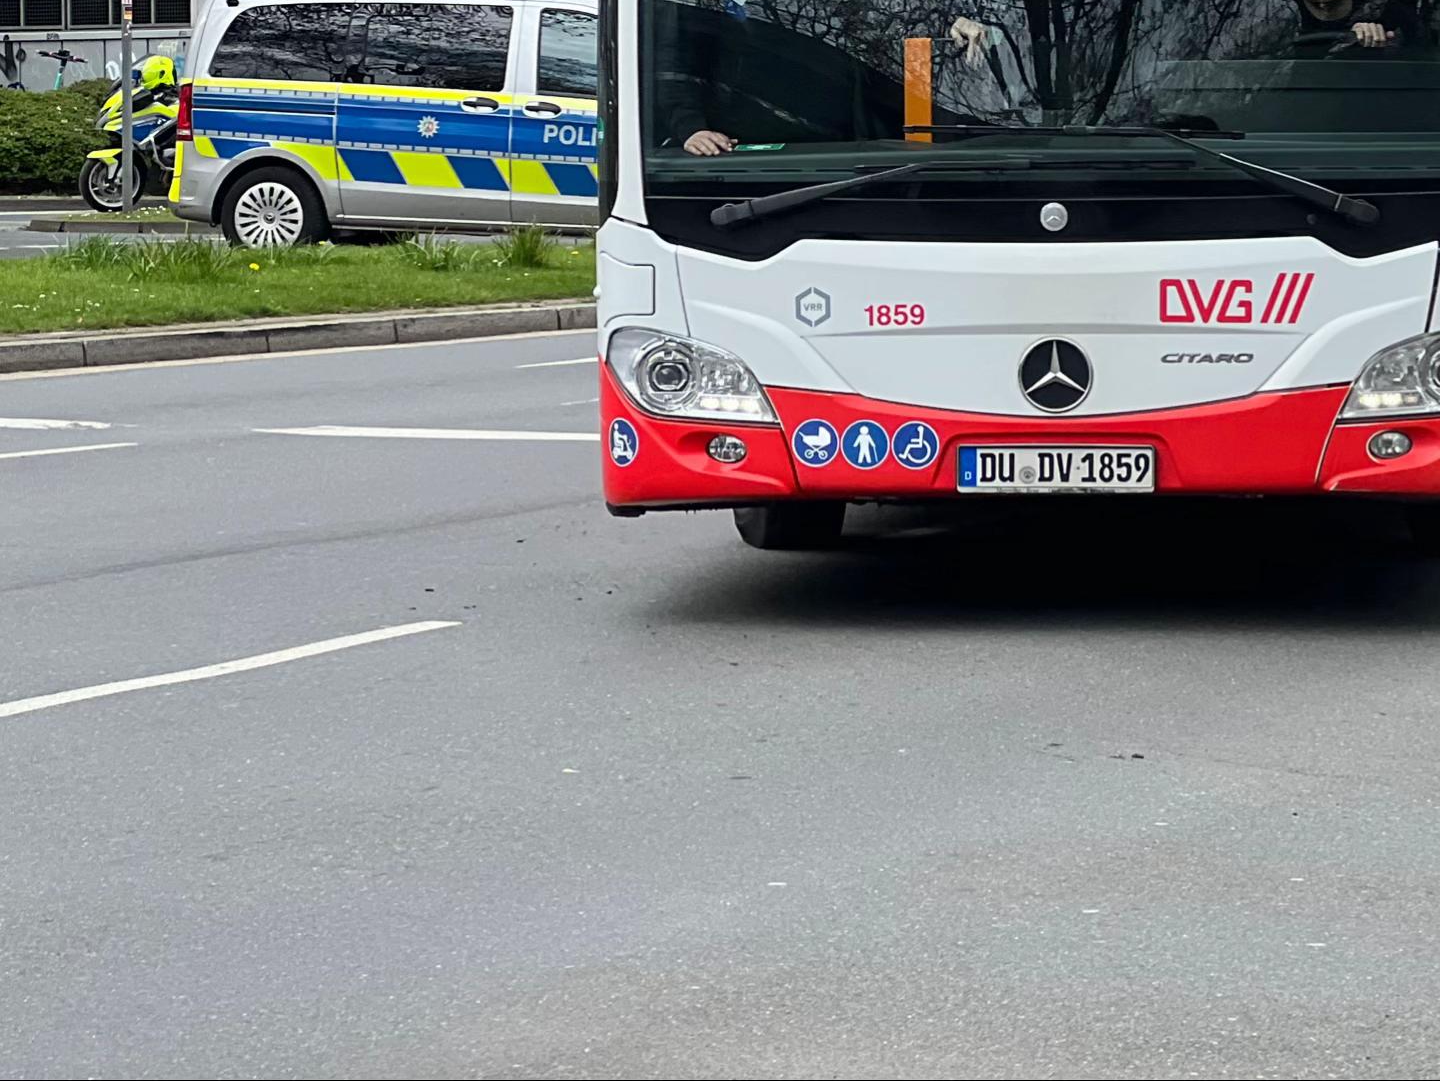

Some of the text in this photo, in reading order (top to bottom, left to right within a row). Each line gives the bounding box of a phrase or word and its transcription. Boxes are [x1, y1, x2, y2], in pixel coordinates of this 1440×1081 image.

[543, 124, 597, 146] POLI
[803, 303, 823, 311] VRR
[864, 304, 925, 326] 1859
[1160, 353, 1254, 364] CITARO
[979, 452, 1150, 482] DU DV 1859
[964, 471, 972, 481] D
